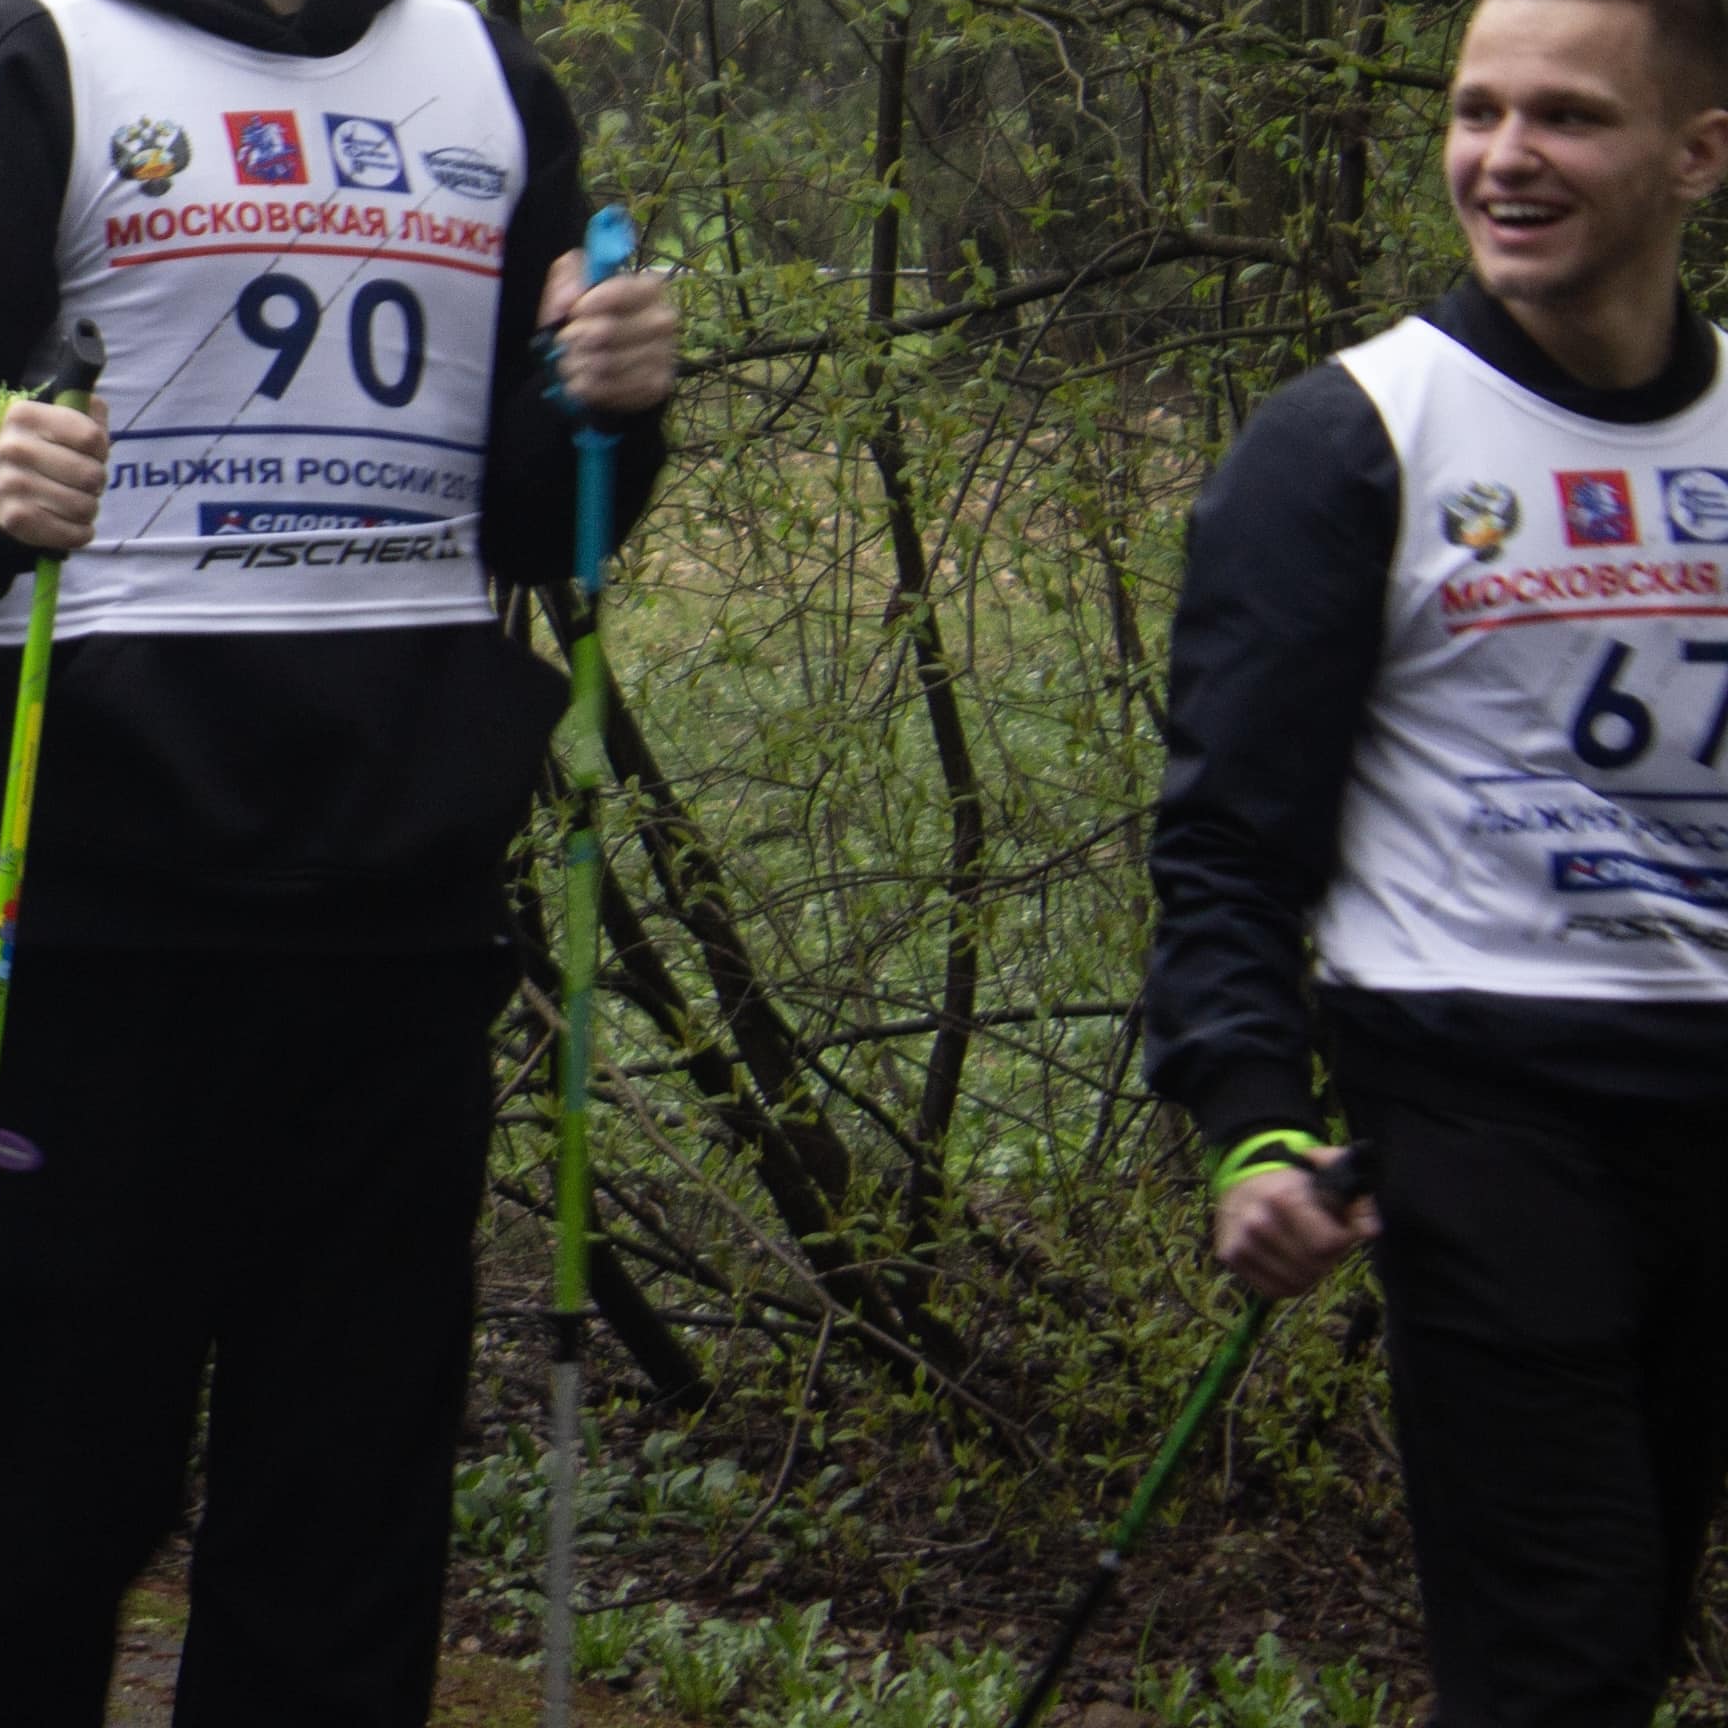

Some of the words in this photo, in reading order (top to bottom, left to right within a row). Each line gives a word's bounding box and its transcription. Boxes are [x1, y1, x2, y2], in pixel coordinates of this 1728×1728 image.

[105, 201, 387, 249] МОСКОВСКАЯ
[400, 208, 504, 257] ЛЫЖН
[236, 272, 425, 408] 90
[109, 458, 283, 491] ЛЫЖНЯ
[195, 535, 436, 570] FISCHER
[1441, 561, 1721, 612] МОСКОВСКАЯ
